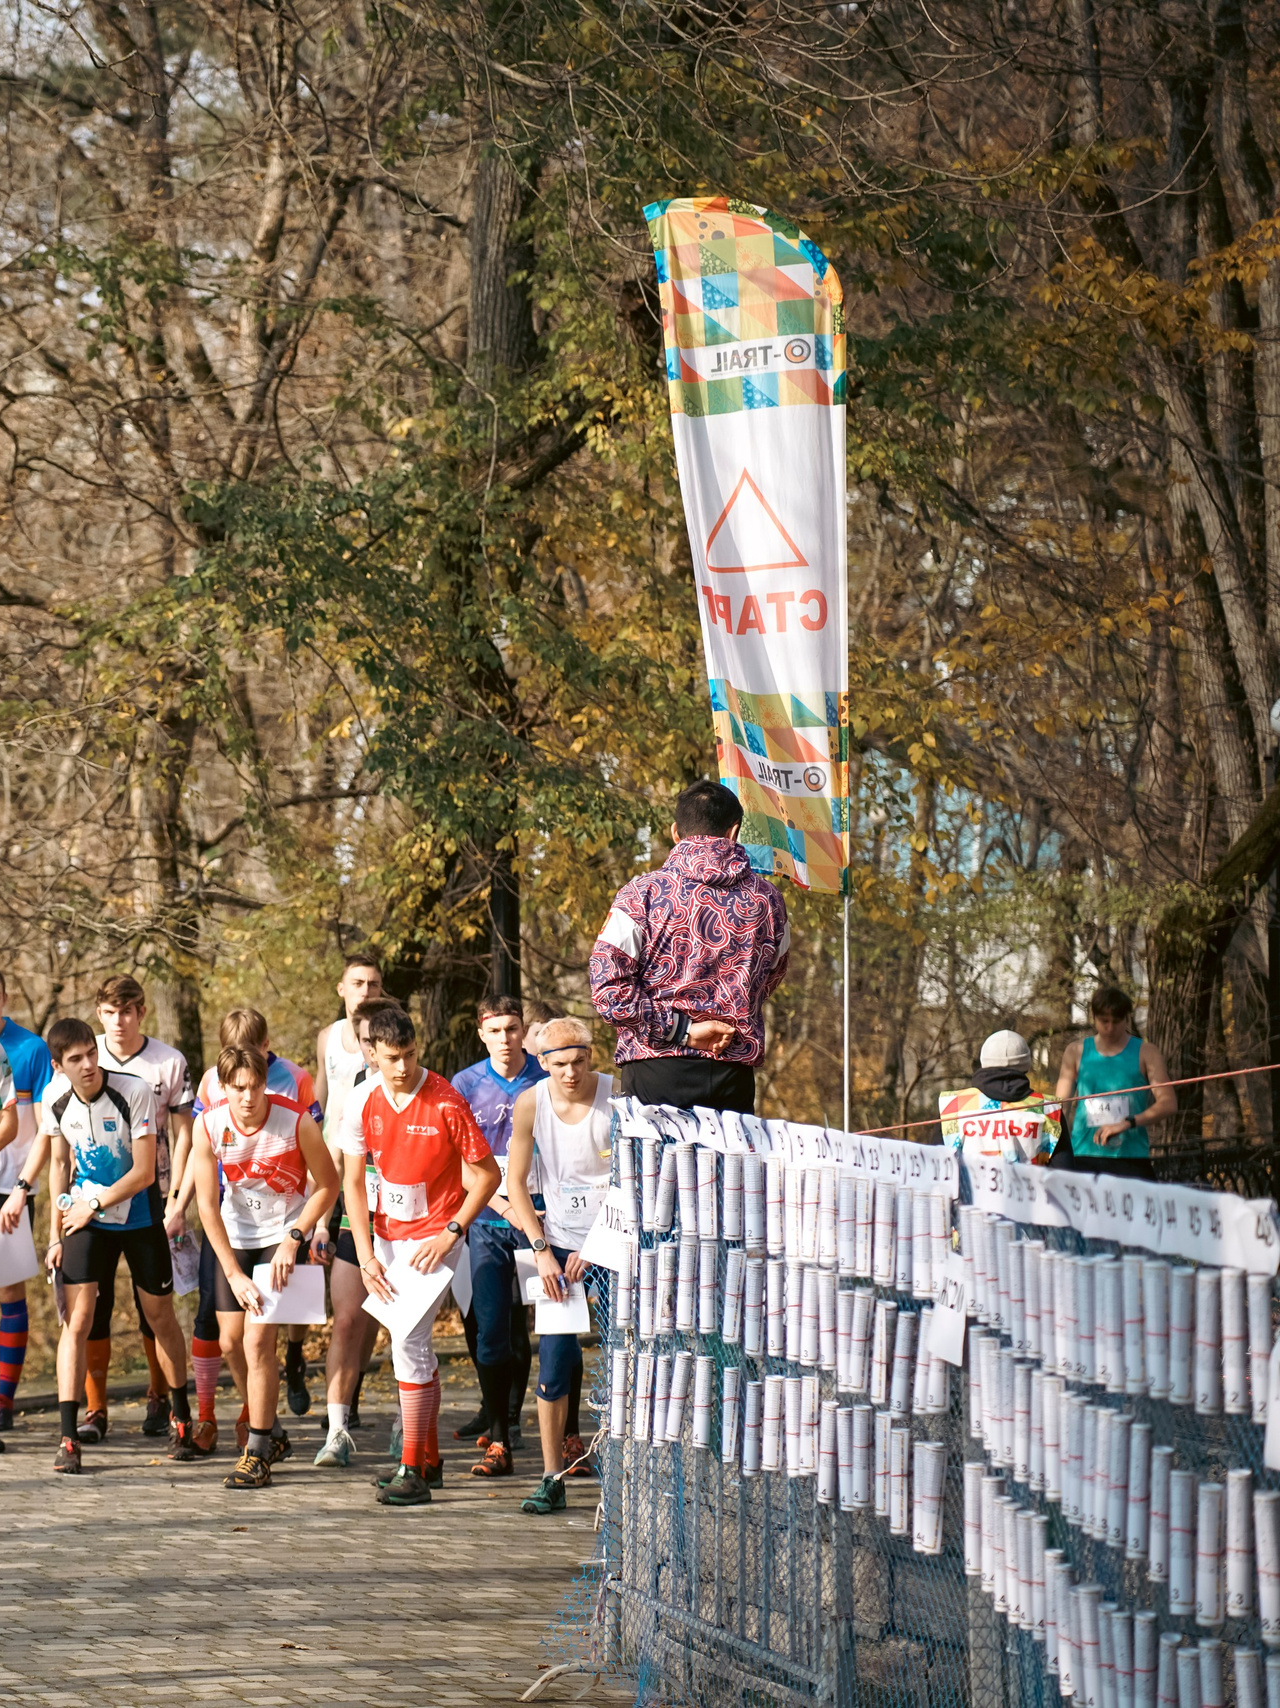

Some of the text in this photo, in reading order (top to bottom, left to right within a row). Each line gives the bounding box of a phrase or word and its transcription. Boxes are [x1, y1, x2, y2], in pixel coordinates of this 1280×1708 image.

[962, 1119, 1040, 1139] СУДЬЯ
[816, 1137, 828, 1158] 10
[246, 1197, 262, 1210] 33
[389, 1192, 404, 1204] 32
[571, 1196, 587, 1208] 31
